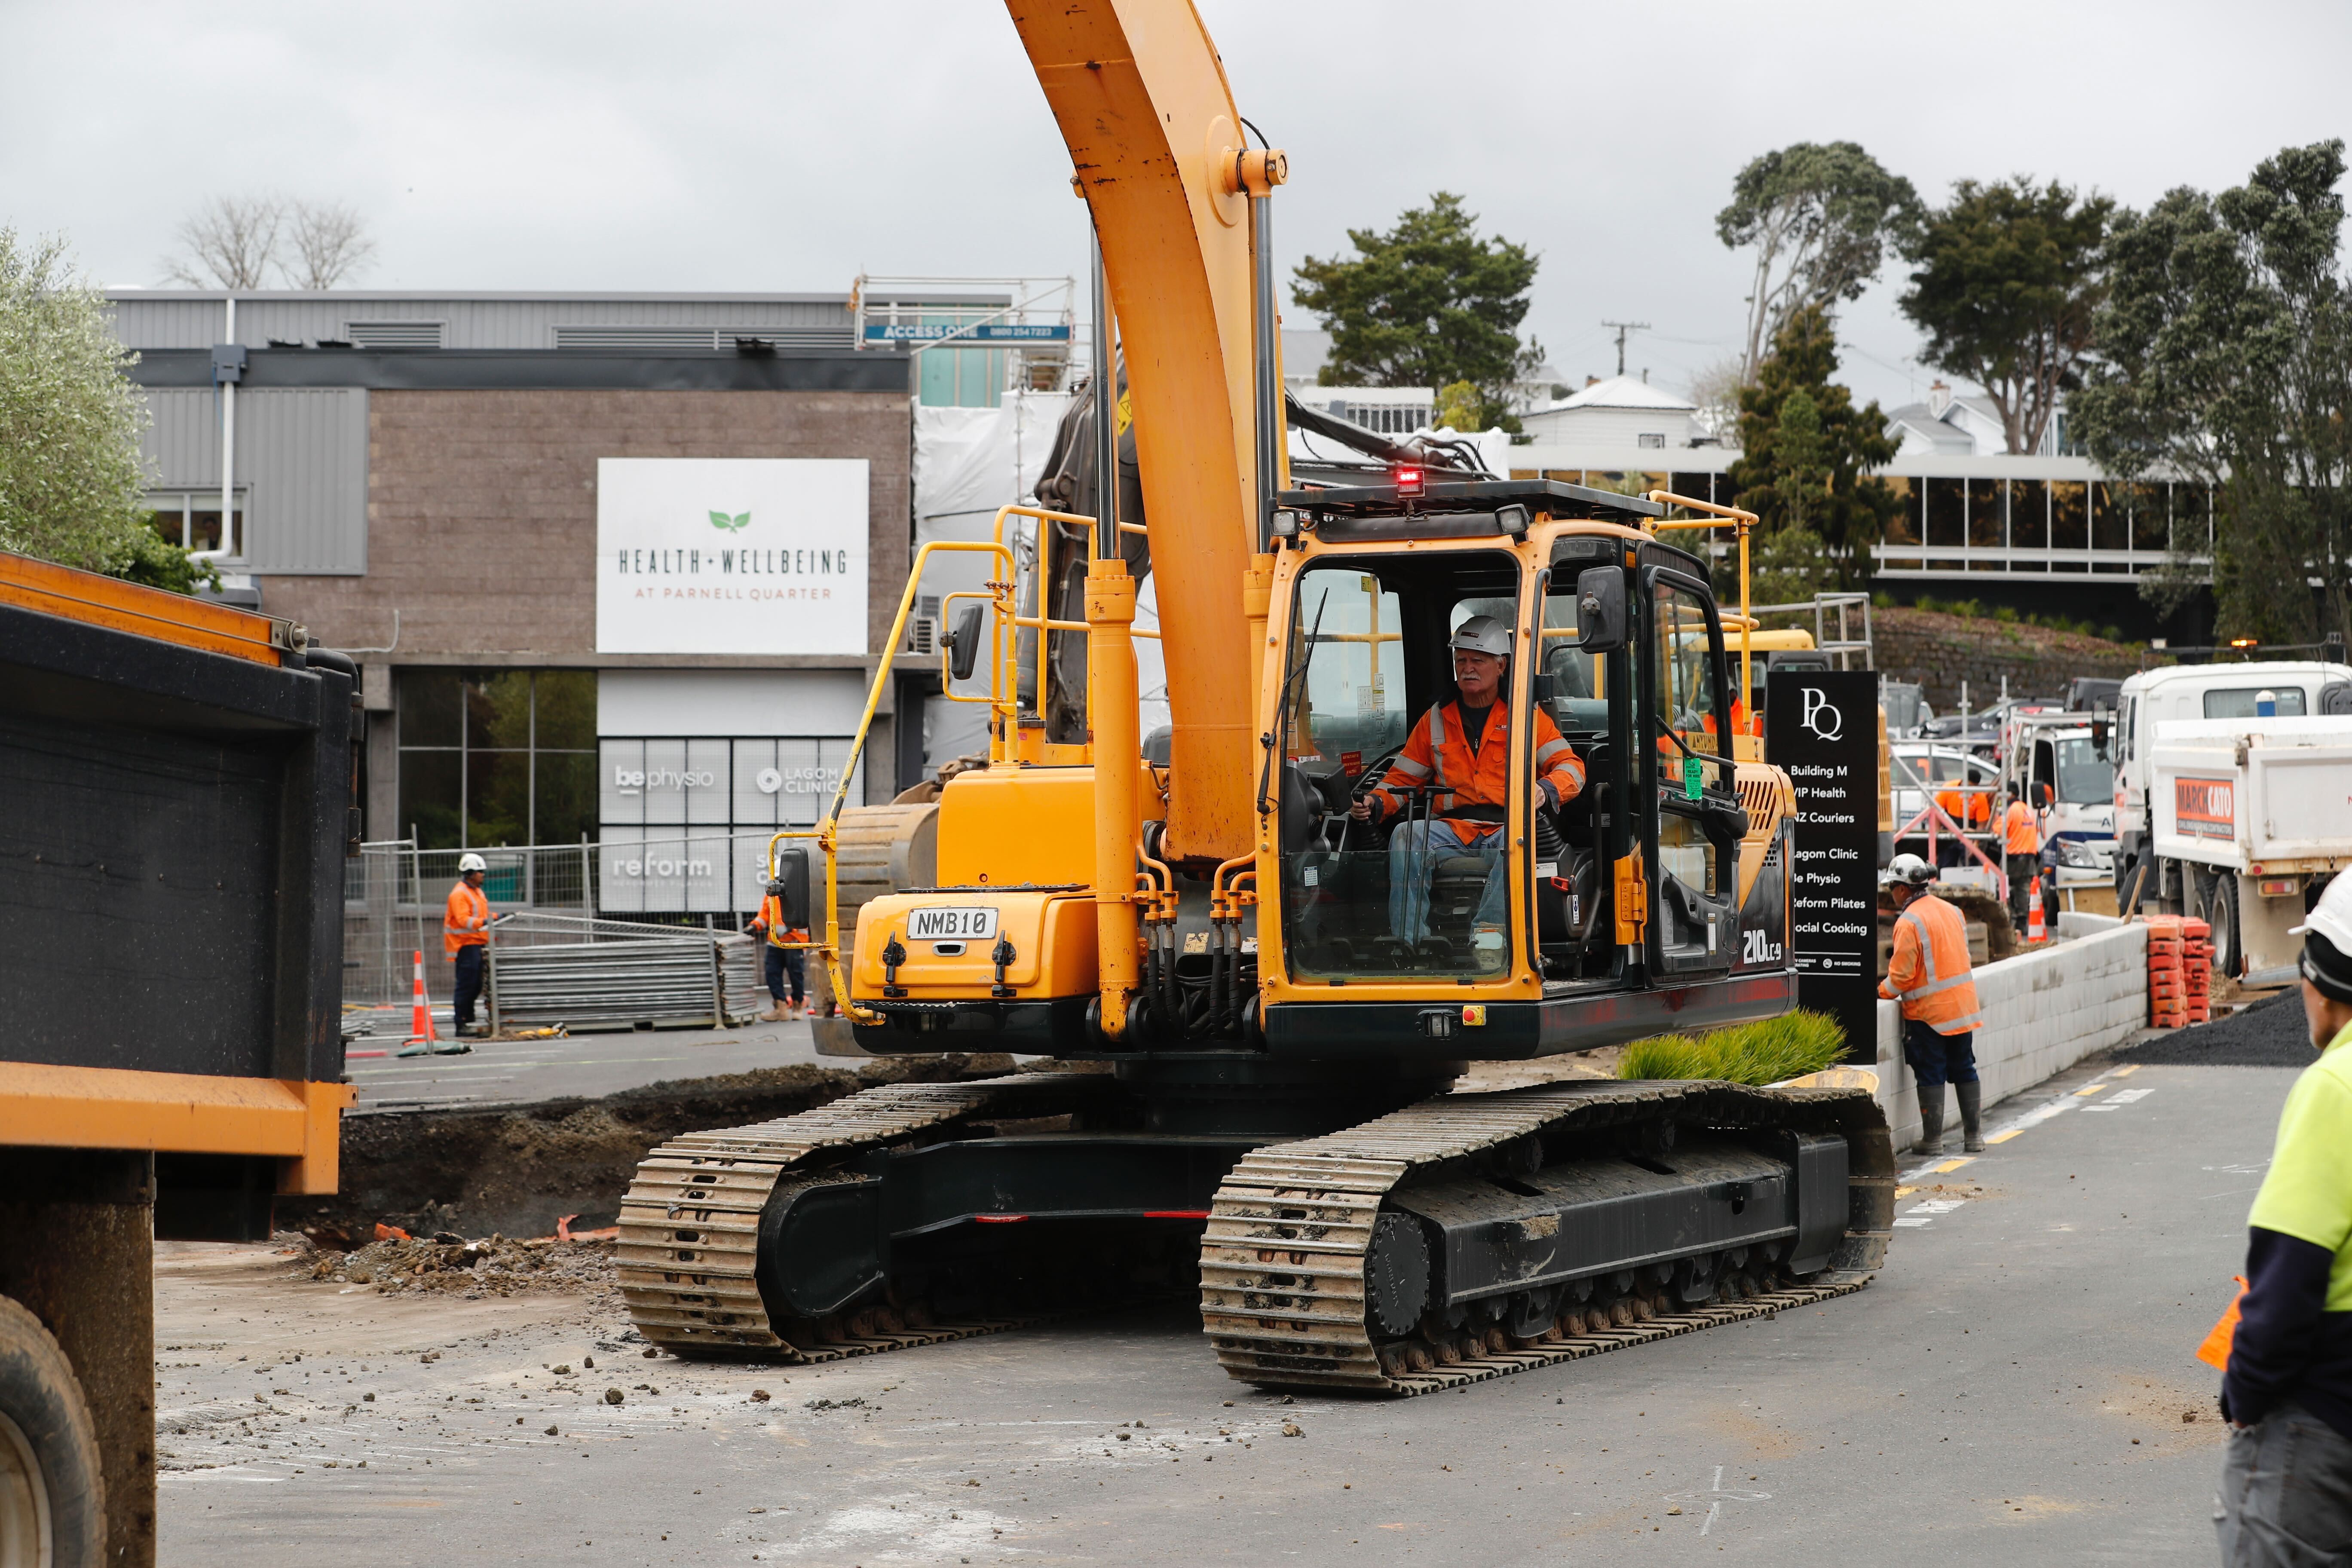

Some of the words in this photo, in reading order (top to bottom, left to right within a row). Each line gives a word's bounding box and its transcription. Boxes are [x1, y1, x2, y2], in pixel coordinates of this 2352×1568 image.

[884, 325, 943, 338] ACCESS
[945, 325, 978, 338] ONE
[990, 327, 1012, 336] 0800
[620, 550, 699, 573] HEALTH
[722, 550, 846, 573] WELLBEING
[636, 588, 654, 598] AT
[664, 588, 743, 599] PARNELL
[749, 588, 831, 601] QUARTER
[1800, 688, 1843, 741] PQ
[786, 768, 838, 780] LAGOM
[1791, 765, 1834, 779] Building
[1837, 766, 1847, 776] M
[786, 781, 837, 793] CLINIC
[1811, 787, 1846, 798] Health
[1795, 812, 1807, 823] NZ
[1809, 812, 1855, 823] Couriers
[1794, 851, 1826, 861] agom
[1828, 848, 1858, 859] Clinic
[613, 851, 711, 876] reform
[1807, 872, 1841, 886] Physio
[1831, 897, 1865, 909] Pilates
[917, 913, 986, 934] NMB10
[1795, 922, 1819, 933] ocial
[1822, 922, 1867, 936] Cooking
